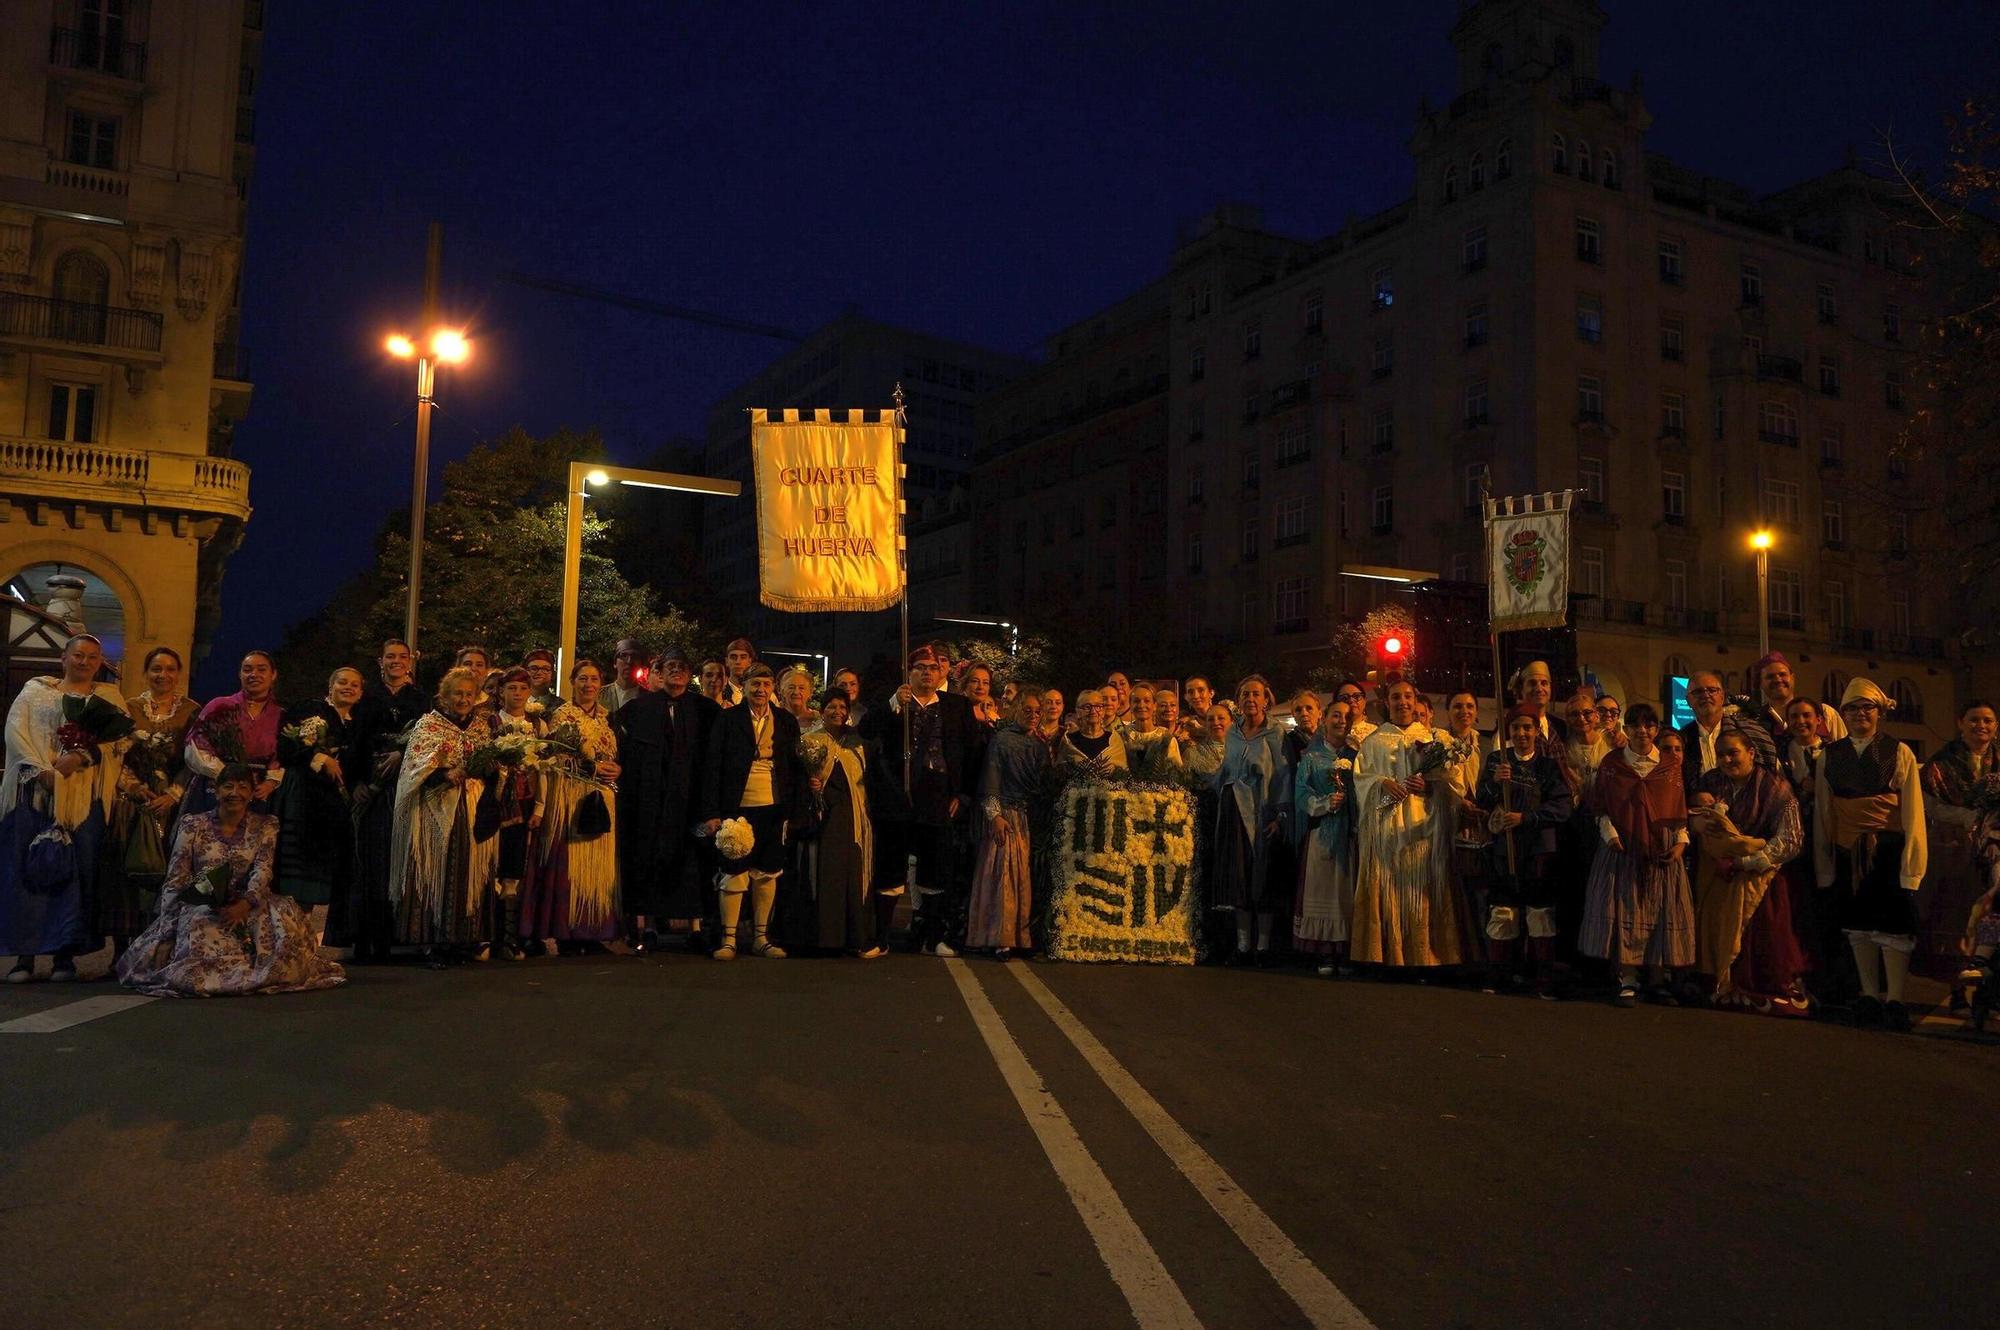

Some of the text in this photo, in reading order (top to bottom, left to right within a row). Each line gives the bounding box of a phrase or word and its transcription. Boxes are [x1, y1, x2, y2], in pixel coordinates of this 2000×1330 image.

[780, 466, 877, 486] CUARTE
[814, 505, 847, 524] DE
[783, 538, 876, 557] HUERVA
